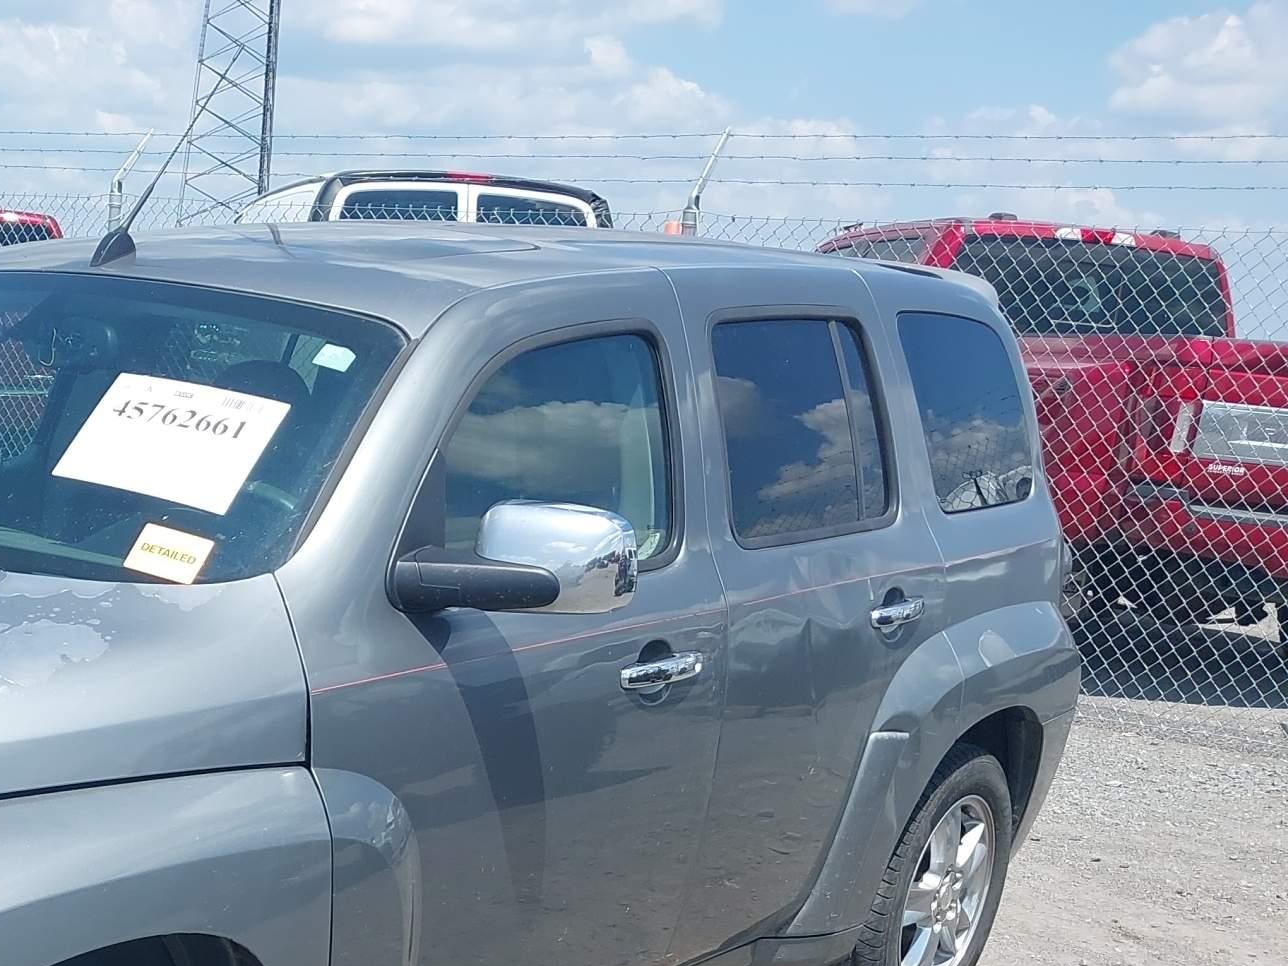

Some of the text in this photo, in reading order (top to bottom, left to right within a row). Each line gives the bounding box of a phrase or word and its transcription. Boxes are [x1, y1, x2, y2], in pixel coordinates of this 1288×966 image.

[112, 399, 247, 439] 45762661
[1207, 463, 1245, 473] SUPERIOR
[140, 542, 197, 565] DETAILED
